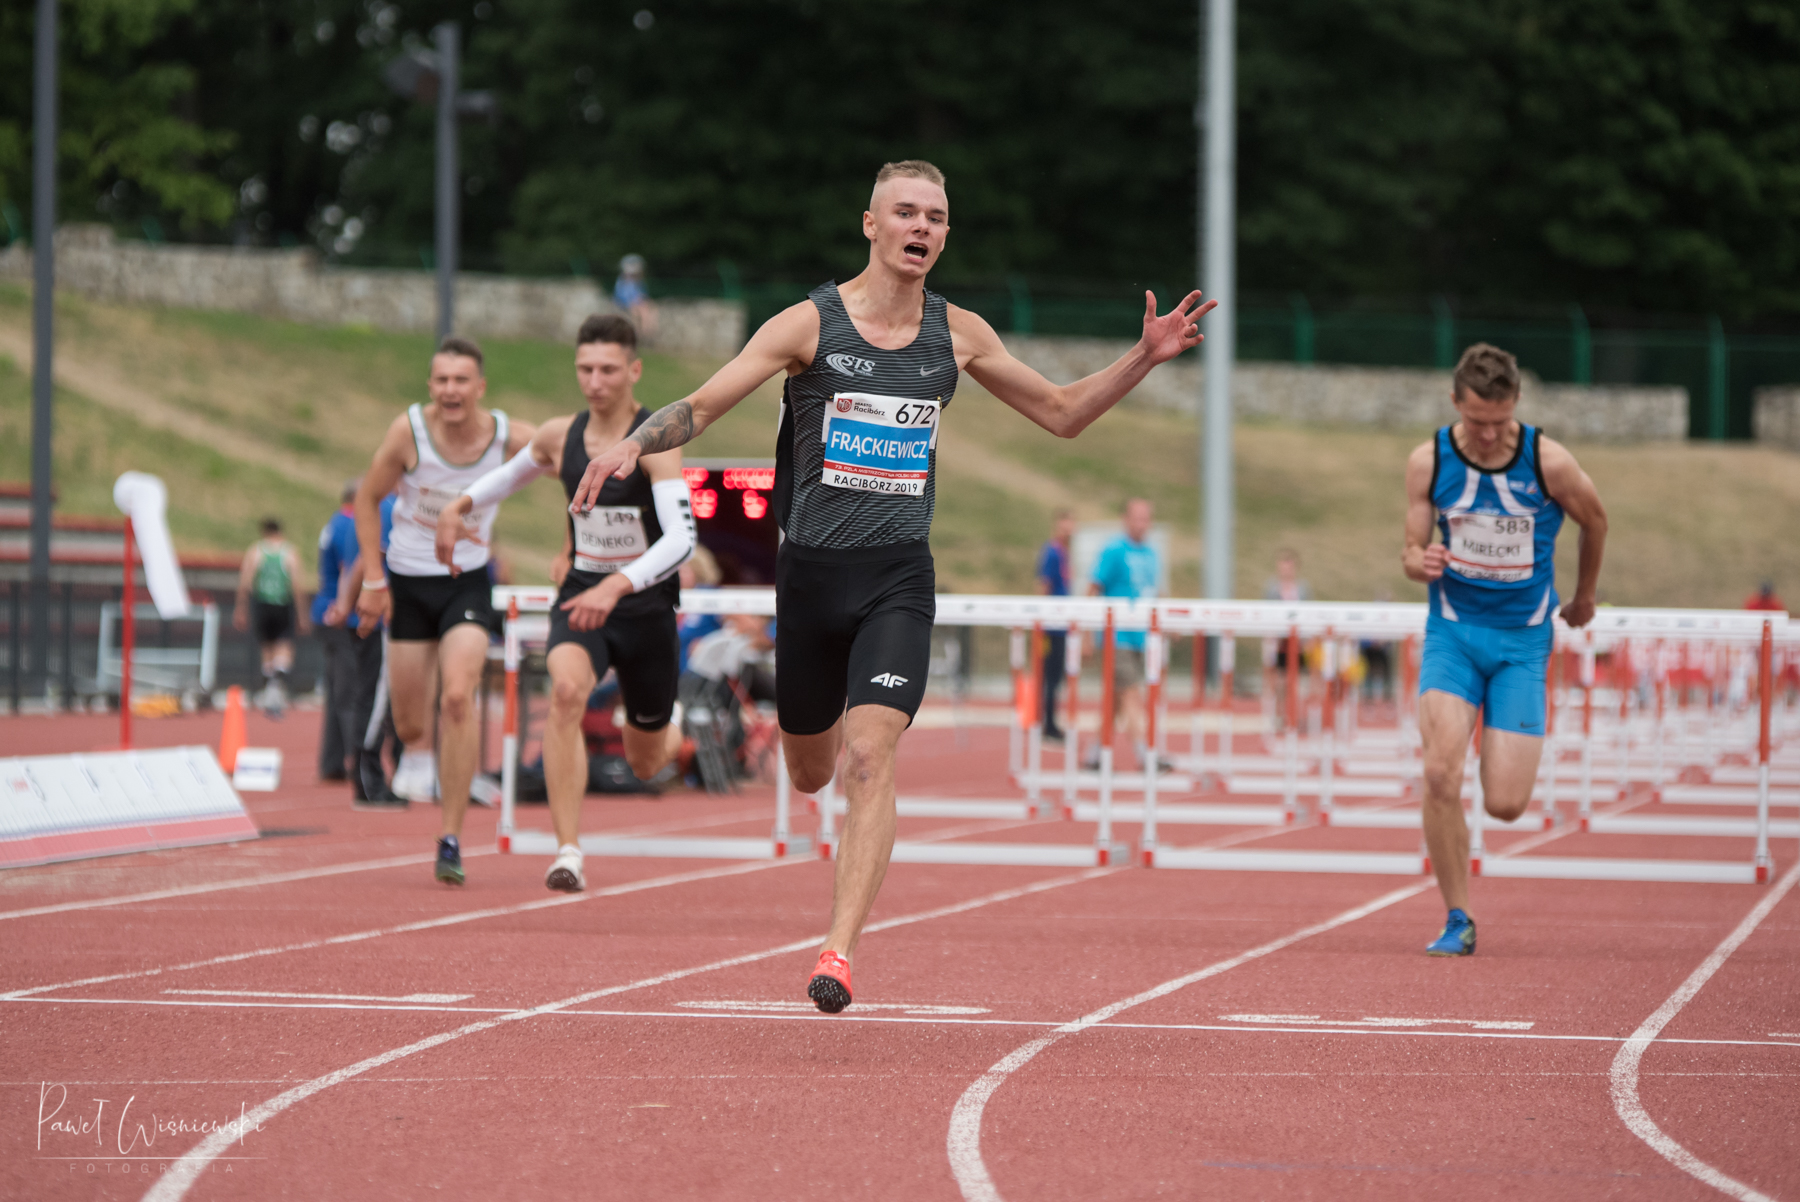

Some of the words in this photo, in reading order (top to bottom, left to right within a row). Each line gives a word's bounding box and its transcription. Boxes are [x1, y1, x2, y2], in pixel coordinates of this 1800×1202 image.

[842, 354, 876, 372] STS
[853, 405, 886, 416] Racibórz
[895, 403, 935, 425] 672
[830, 430, 928, 459] FRĄCKIEWICZ
[833, 474, 891, 492] RACIBÓRZ
[894, 483, 918, 493] 2019
[603, 511, 634, 526] 149
[1495, 519, 1531, 535] 583
[581, 531, 635, 549] DEINEKO
[1463, 539, 1520, 558] MIRECKI
[870, 671, 909, 689] 4F
